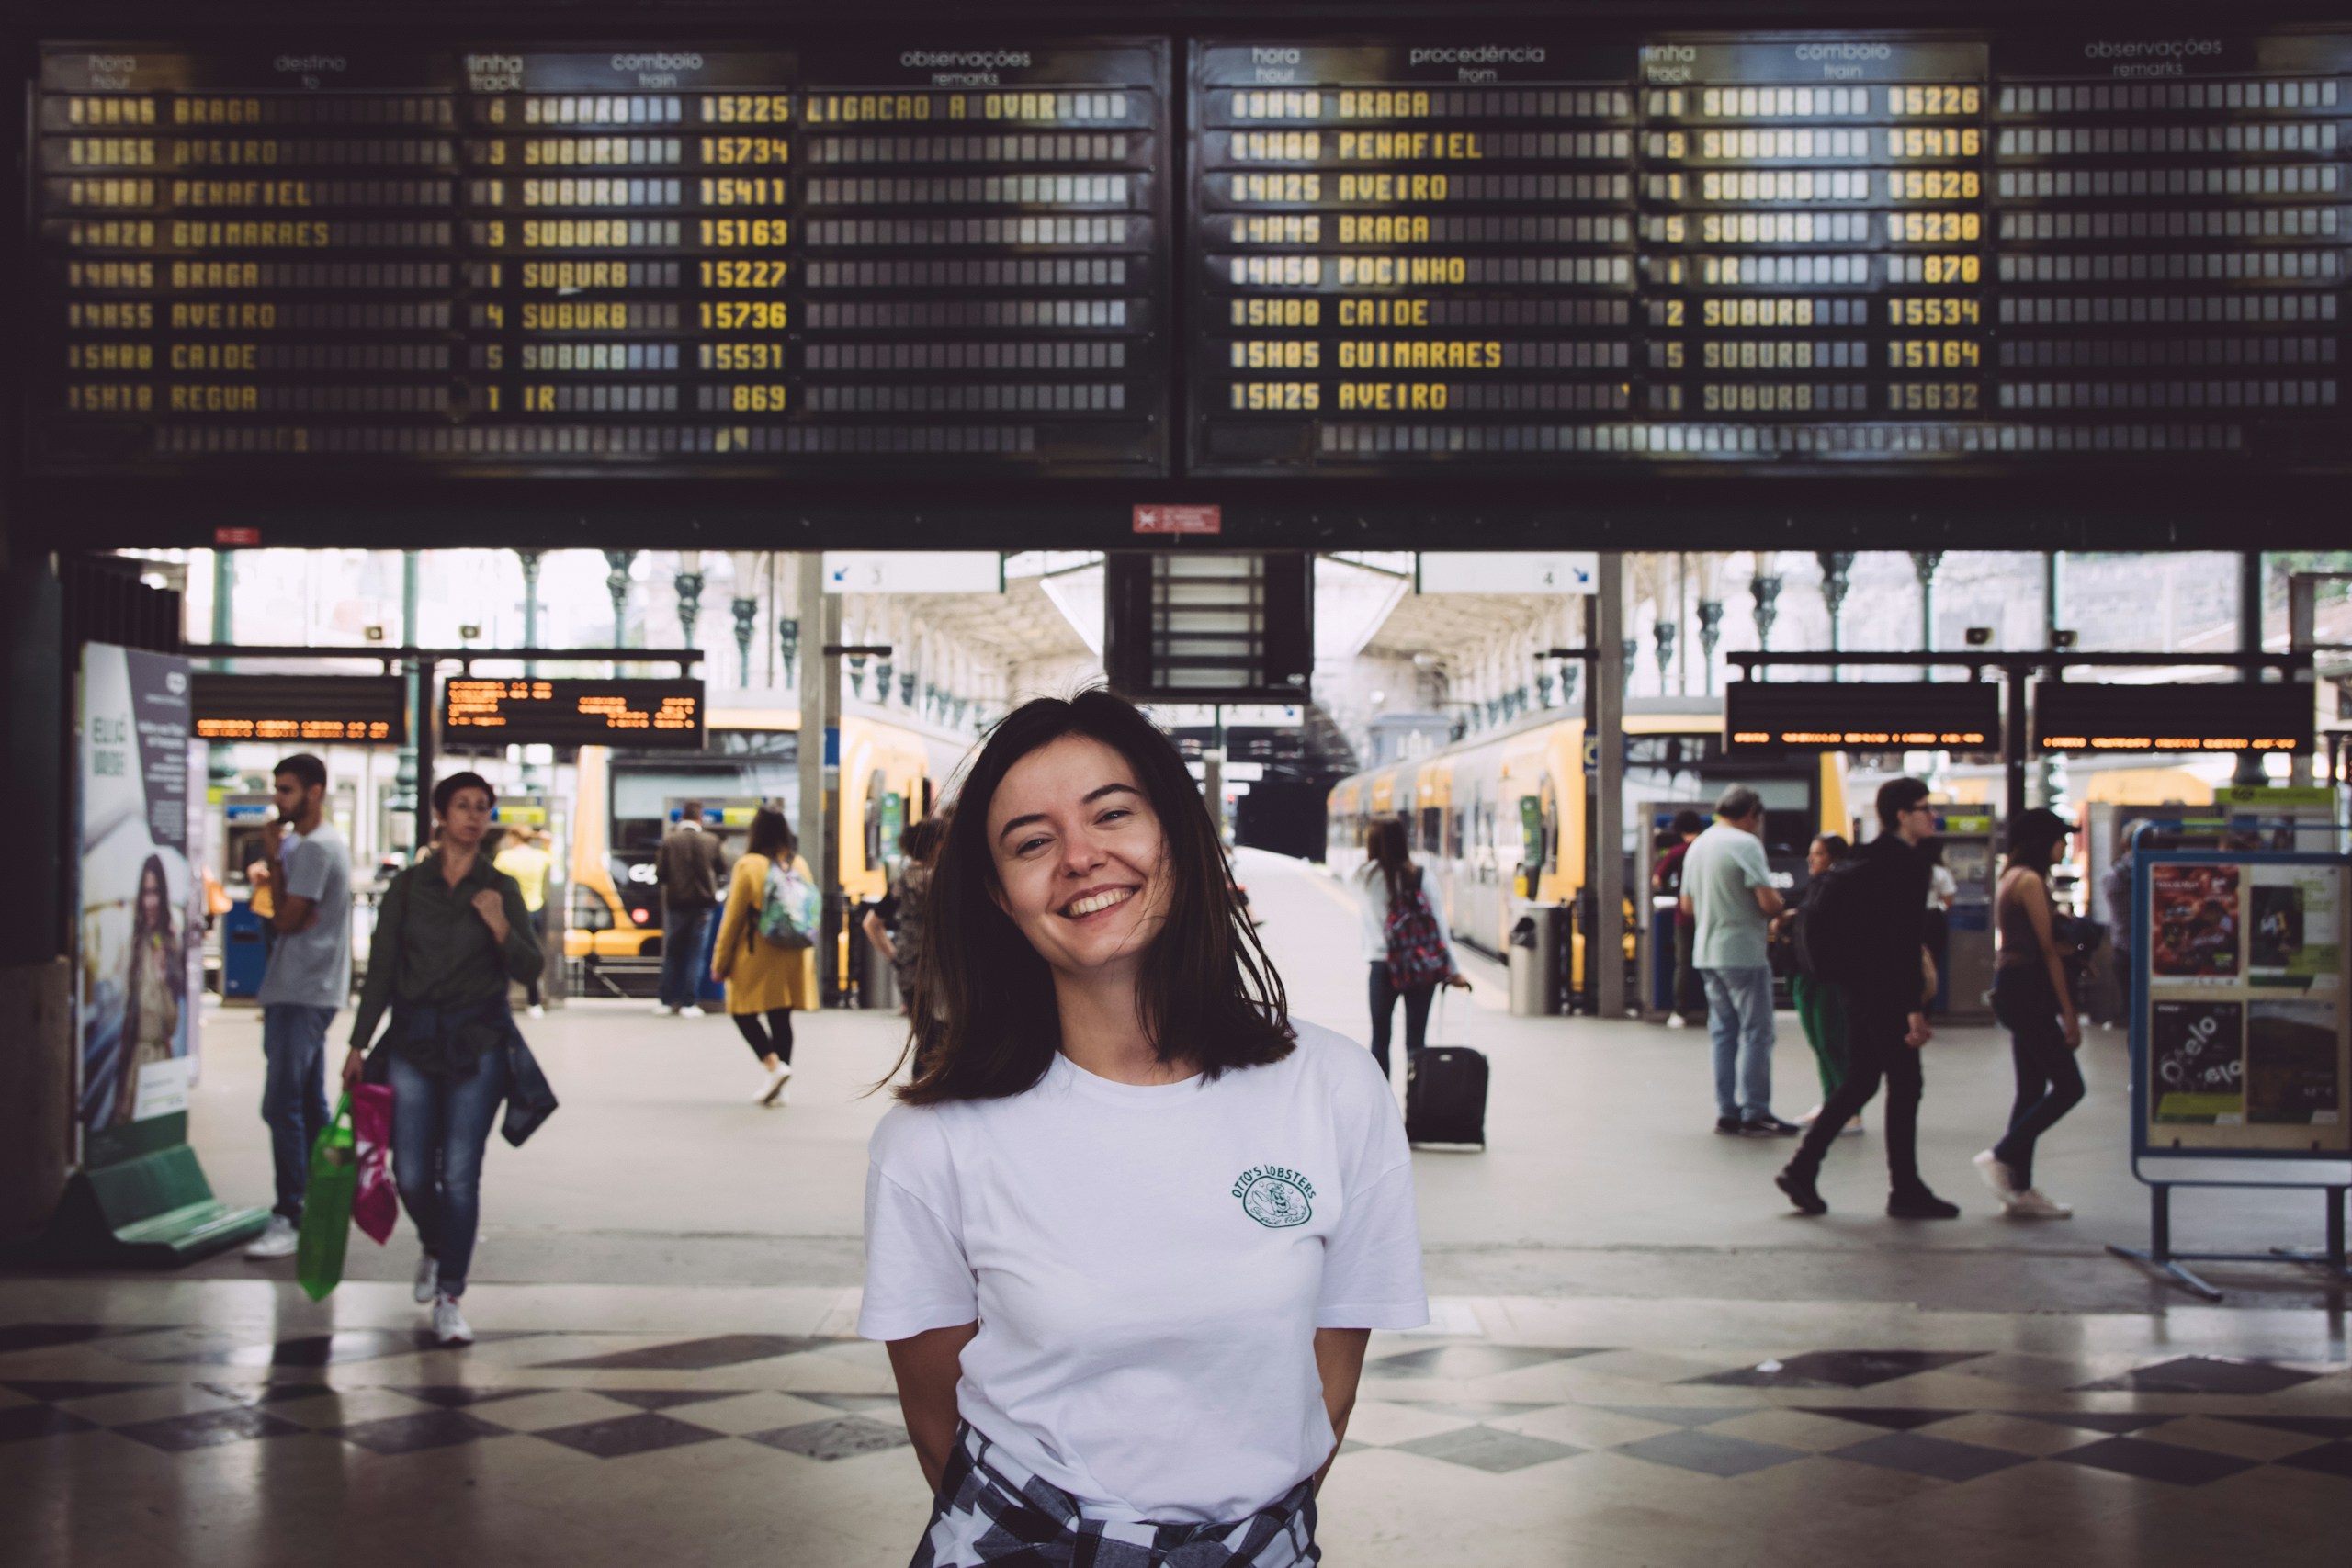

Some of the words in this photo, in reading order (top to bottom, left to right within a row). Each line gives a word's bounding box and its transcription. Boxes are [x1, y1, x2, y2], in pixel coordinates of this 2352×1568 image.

[88, 54, 136, 73] hora
[273, 54, 347, 73] destino
[467, 53, 524, 73] linha
[611, 52, 703, 73] comboio
[900, 50, 1031, 71] observações
[1252, 46, 1300, 65] hora
[1410, 45, 1545, 67] procedência
[1645, 44, 1696, 62] linha
[1795, 43, 1891, 61] comboio
[2084, 38, 2222, 60] observações
[92, 73, 130, 89] hour
[301, 73, 320, 89] to
[469, 73, 521, 91] track
[639, 72, 677, 89] train
[932, 71, 1000, 87] remarks
[1255, 66, 1295, 84] hour
[1458, 68, 1498, 85] from
[1647, 62, 1692, 81] track
[1823, 62, 1863, 80] train
[2112, 60, 2185, 77] remarks
[701, 95, 790, 123] 15225
[807, 94, 931, 122] LIGACAO
[949, 94, 966, 120] A
[985, 93, 1056, 120] OVAR
[1339, 90, 1430, 118] BRAGA
[1888, 85, 1980, 115] 15226
[489, 137, 505, 164] 3
[701, 137, 789, 164] 15734
[1339, 132, 1483, 159] PENAFIEL
[1667, 130, 1685, 158] 3
[1888, 127, 1980, 157] 15416
[173, 179, 311, 206] PENAFIEL
[490, 178, 503, 206] 1
[700, 178, 786, 206] 15411
[1339, 174, 1447, 201] AVEIRO
[1667, 172, 1682, 200] 1
[1888, 169, 1980, 199] 15628
[172, 220, 330, 247] GUIMARAES
[488, 220, 504, 247] 3
[523, 220, 628, 247] SUBURB
[700, 219, 787, 247] 15163
[1339, 215, 1430, 243] BRAGA
[1667, 214, 1685, 242] 5
[172, 261, 258, 288] BRAGA
[490, 262, 503, 288] 1
[522, 262, 628, 288] SUBURB
[700, 261, 786, 288] 15227
[1339, 256, 1466, 284] POCINHO
[1668, 255, 1682, 284] 1
[1705, 255, 1739, 284] IR
[172, 303, 276, 329] AVEIRO
[487, 302, 503, 329] 4
[522, 302, 628, 329] SUBURB
[700, 302, 786, 329] 15736
[1231, 299, 1321, 326] 15H00
[1339, 299, 1429, 326] CAIDE
[1667, 299, 1685, 326] 2
[1703, 298, 1813, 326] SUBURB
[1889, 298, 1980, 326] 15534
[171, 344, 257, 370] CAIDE
[487, 344, 503, 370] 5
[522, 344, 627, 370] SUBURB
[699, 344, 783, 370] 15531
[1231, 341, 1321, 367] 15H05
[1339, 341, 1503, 367] GUIMARAES
[1667, 341, 1685, 368] 5
[1703, 341, 1813, 368] SUBURB
[1889, 340, 1980, 367] 15164
[171, 385, 258, 412] REGUA
[488, 385, 500, 412] 1
[524, 385, 556, 412] IR
[733, 385, 786, 412] 869
[1231, 382, 1321, 410] 15H25
[1668, 384, 1682, 411] 1
[1703, 383, 1813, 411] SUBURB
[1889, 383, 1980, 411] 15632
[1231, 1166, 1261, 1199] OTTO'S
[1263, 1164, 1317, 1199] LOBSTERS
